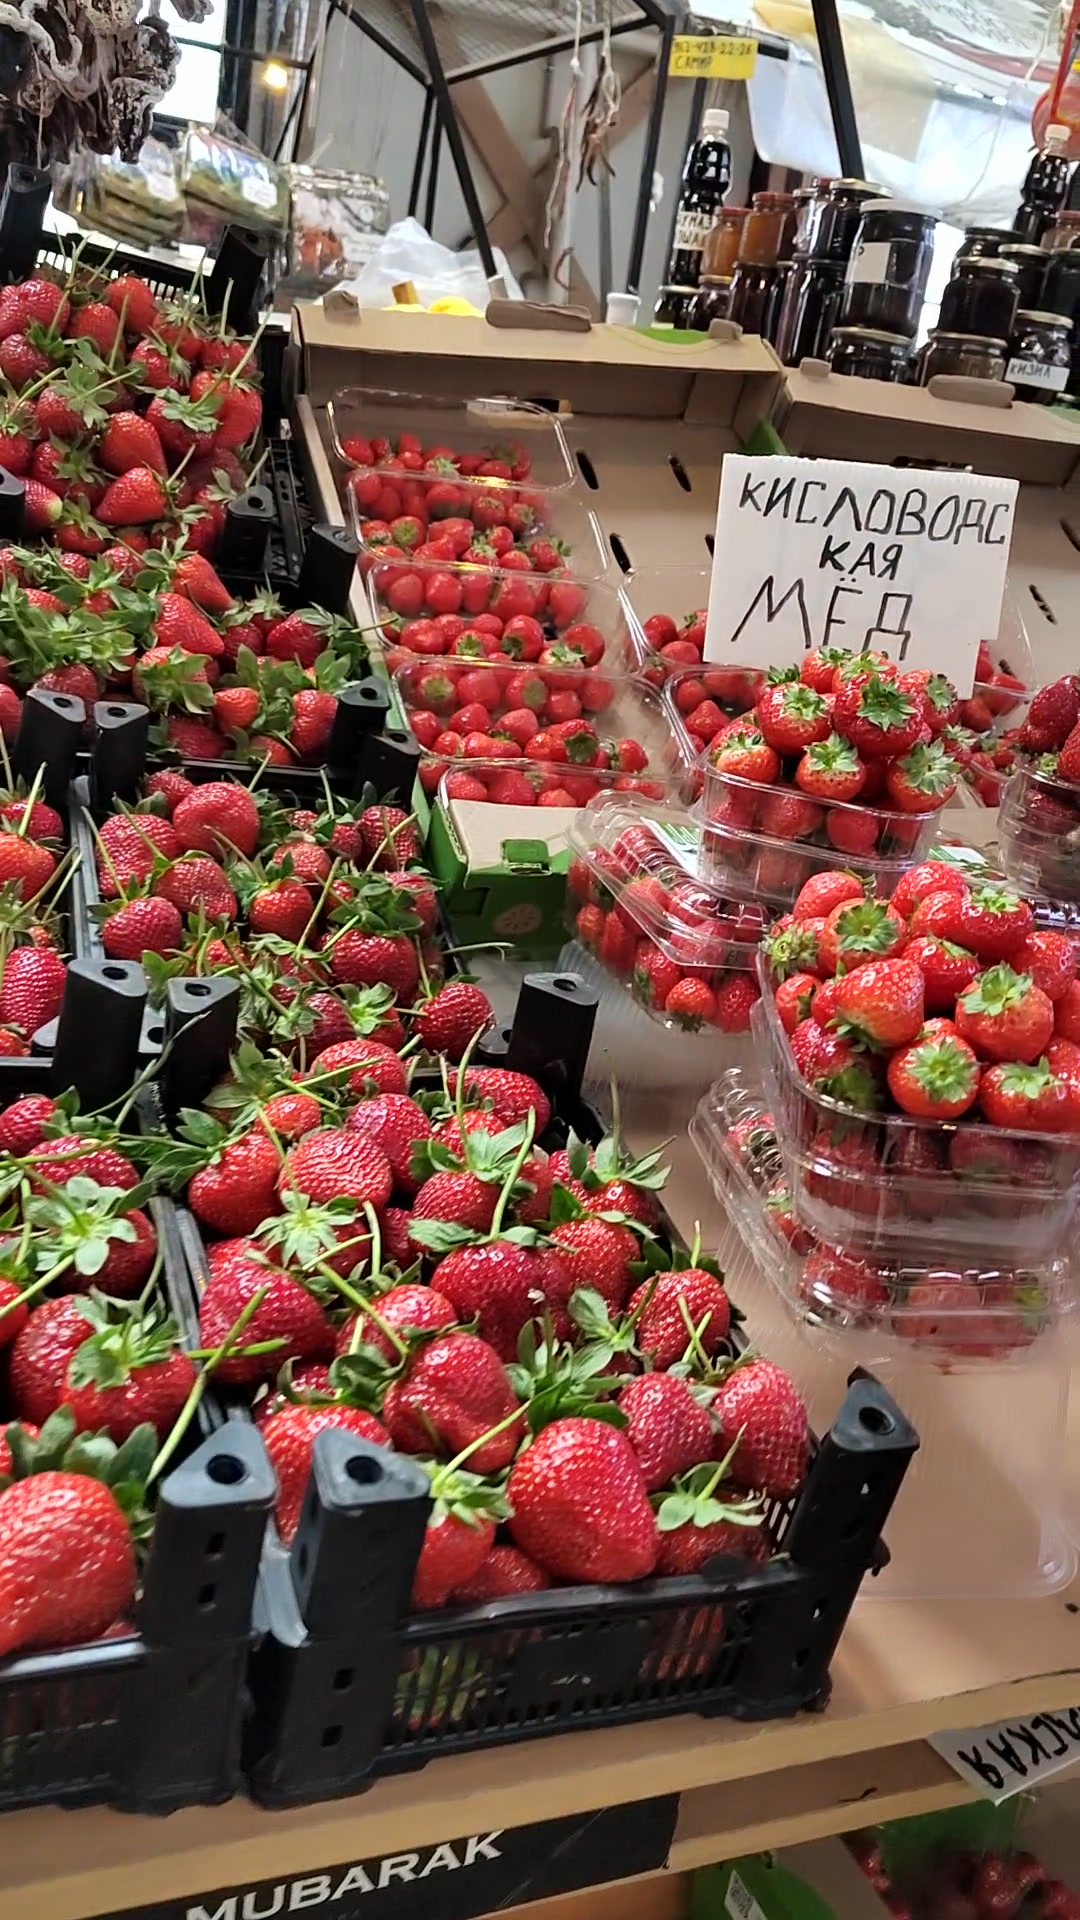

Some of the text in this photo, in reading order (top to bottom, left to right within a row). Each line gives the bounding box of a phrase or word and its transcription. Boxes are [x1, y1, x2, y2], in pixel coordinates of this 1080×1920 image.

[738, 471, 1010, 545] КИСЛОВОДС
[818, 534, 904, 581] КАЯ
[730, 575, 913, 661] МЁД
[185, 1828, 505, 1920] MUBARAK
